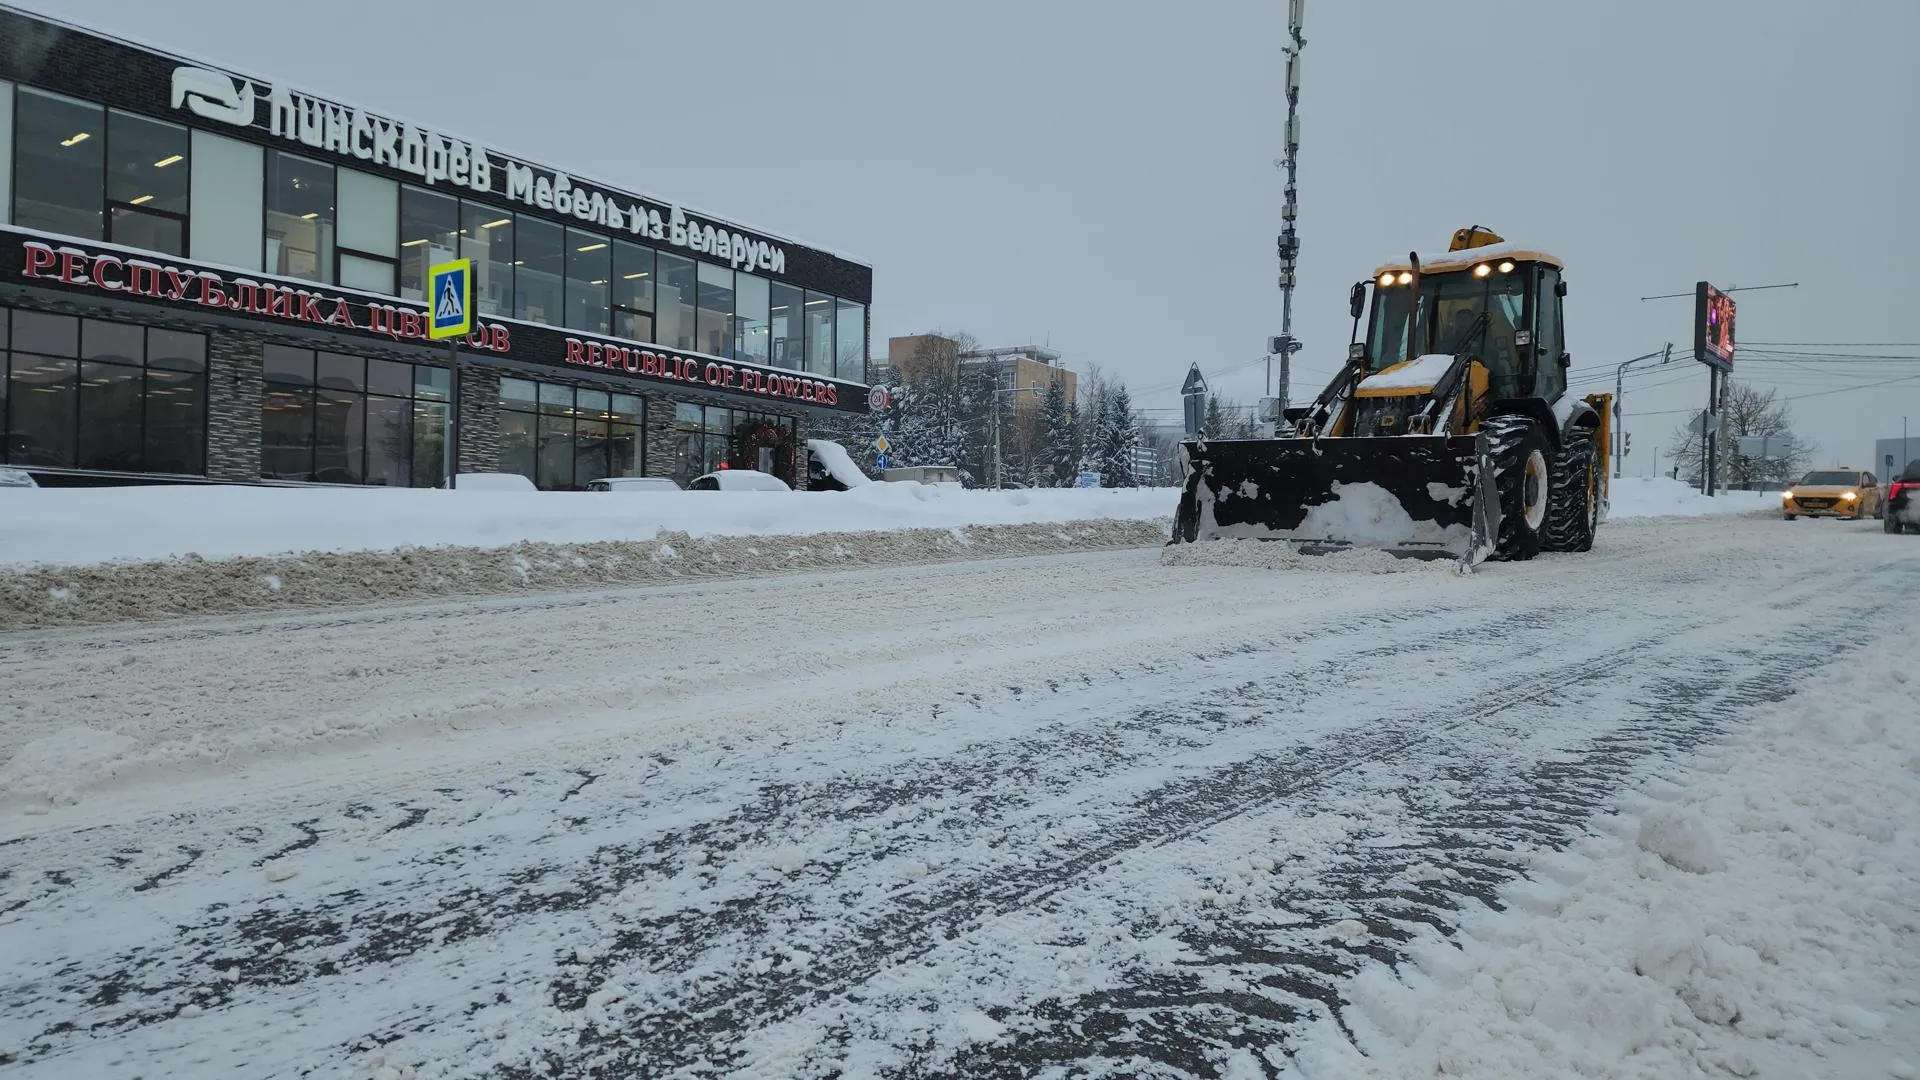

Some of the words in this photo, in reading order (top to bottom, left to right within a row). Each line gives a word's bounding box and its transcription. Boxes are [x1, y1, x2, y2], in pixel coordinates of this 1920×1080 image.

[506, 161, 623, 229] Мебель
[631, 204, 663, 239] из
[670, 203, 785, 274] Беларуси
[22, 241, 356, 329] РЕСПУБЛИКА
[368, 303, 511, 352] ЦВОВ
[565, 338, 698, 382] REPUBLIC
[705, 362, 735, 387] OF
[741, 368, 838, 406] FLOWERS
